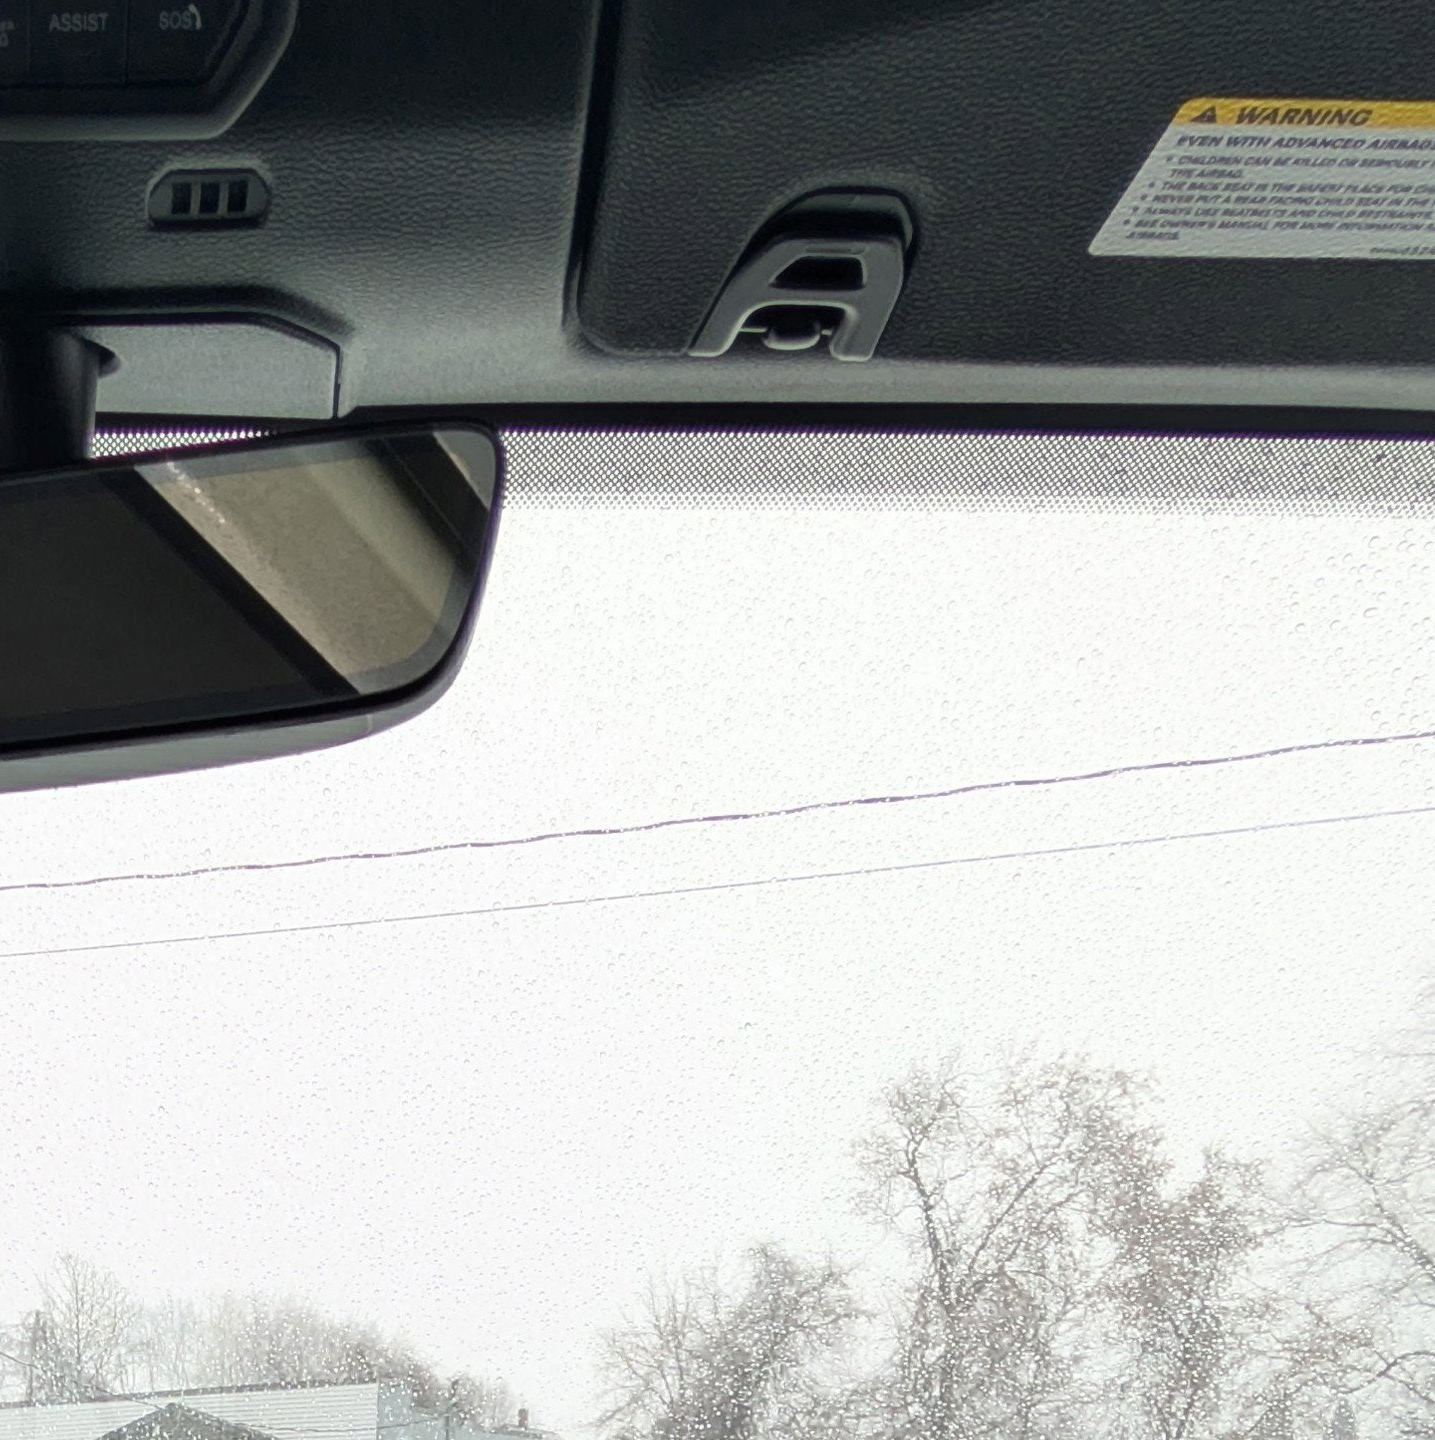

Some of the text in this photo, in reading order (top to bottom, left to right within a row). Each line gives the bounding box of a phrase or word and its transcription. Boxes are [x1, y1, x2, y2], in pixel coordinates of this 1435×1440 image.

[49, 13, 109, 32] ASSIST
[159, 11, 192, 31] SOS
[1231, 107, 1376, 125] WARNING
[1222, 136, 1273, 148] WITH
[1270, 136, 1369, 149] ADVANCED
